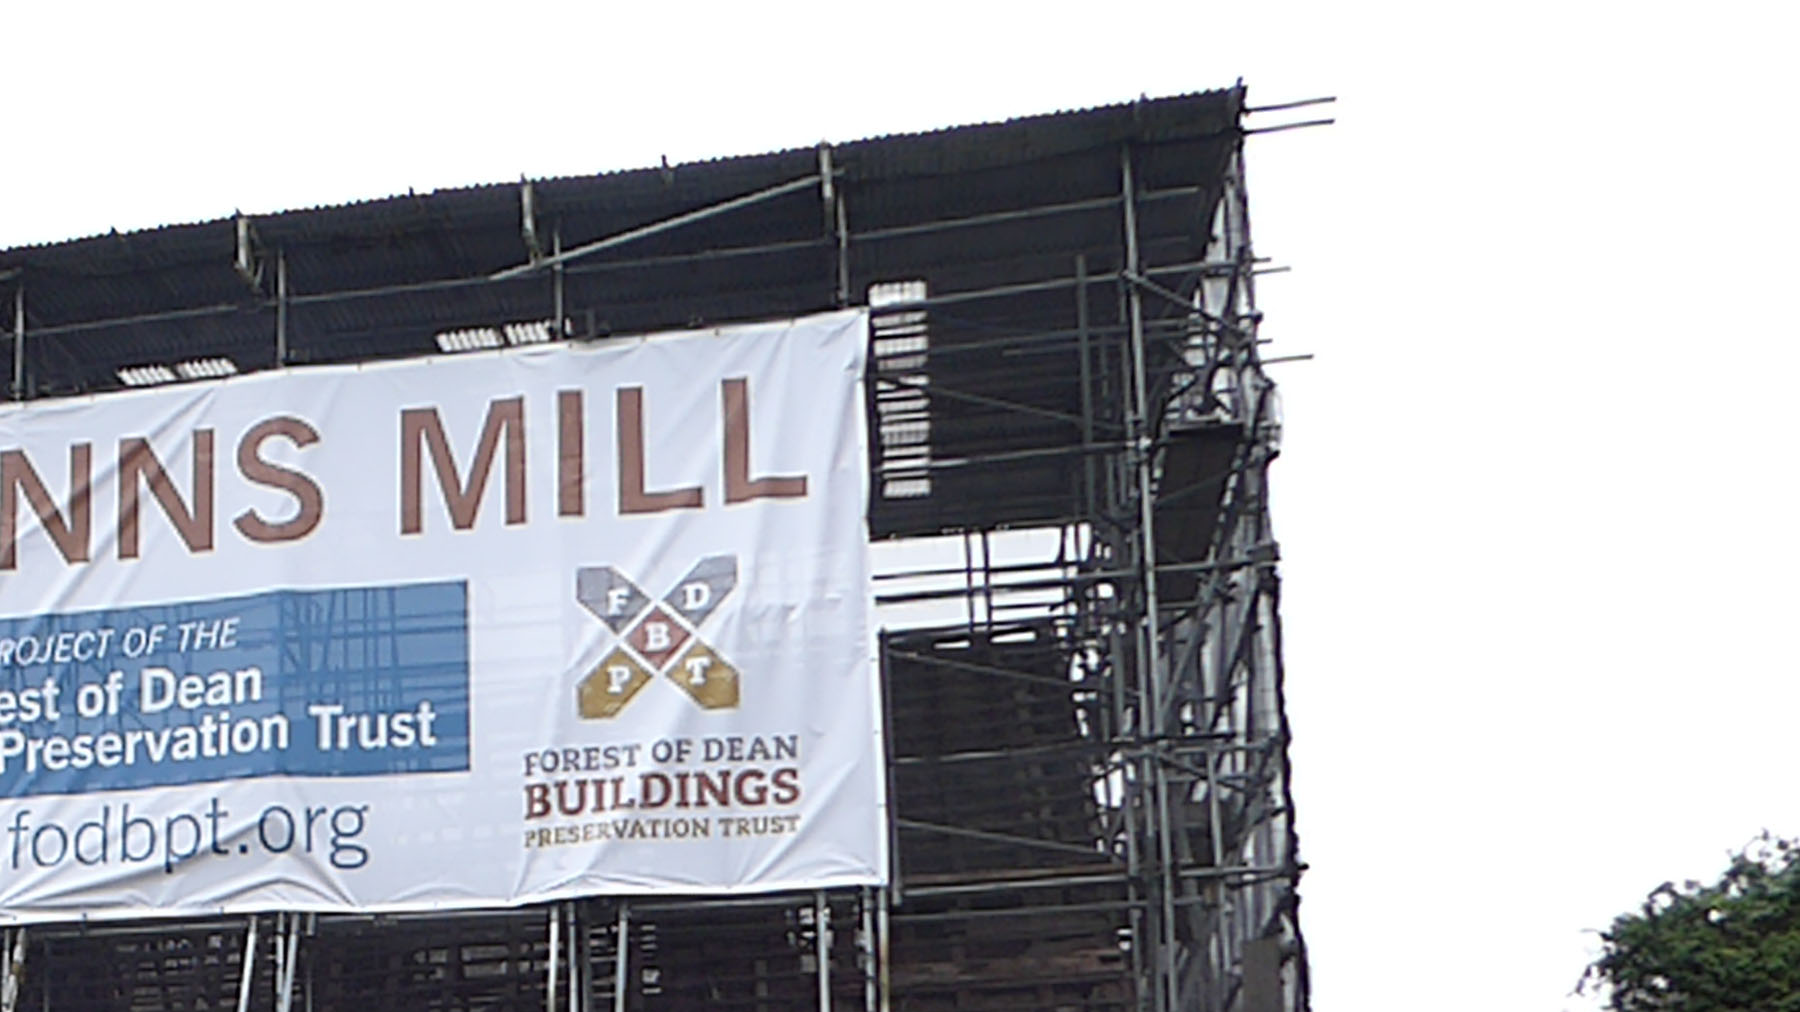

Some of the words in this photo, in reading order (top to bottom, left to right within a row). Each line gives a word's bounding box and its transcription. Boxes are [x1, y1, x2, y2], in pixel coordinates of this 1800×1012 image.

[399, 376, 809, 537] MILL
[607, 587, 629, 615] F
[681, 584, 710, 610] D
[124, 626, 164, 658] OF
[177, 618, 240, 650] THE
[644, 622, 671, 651] B
[77, 682, 125, 718] of
[140, 667, 263, 714] Dean
[606, 664, 629, 692] P
[686, 657, 710, 684] T
[308, 702, 438, 749] Trust
[524, 744, 641, 777] FOREST
[651, 740, 693, 764] OF
[704, 734, 798, 763] DEAN
[524, 767, 800, 820] BUILDINGS
[524, 817, 710, 848] PRESERVATION
[718, 815, 800, 839] TRUST
